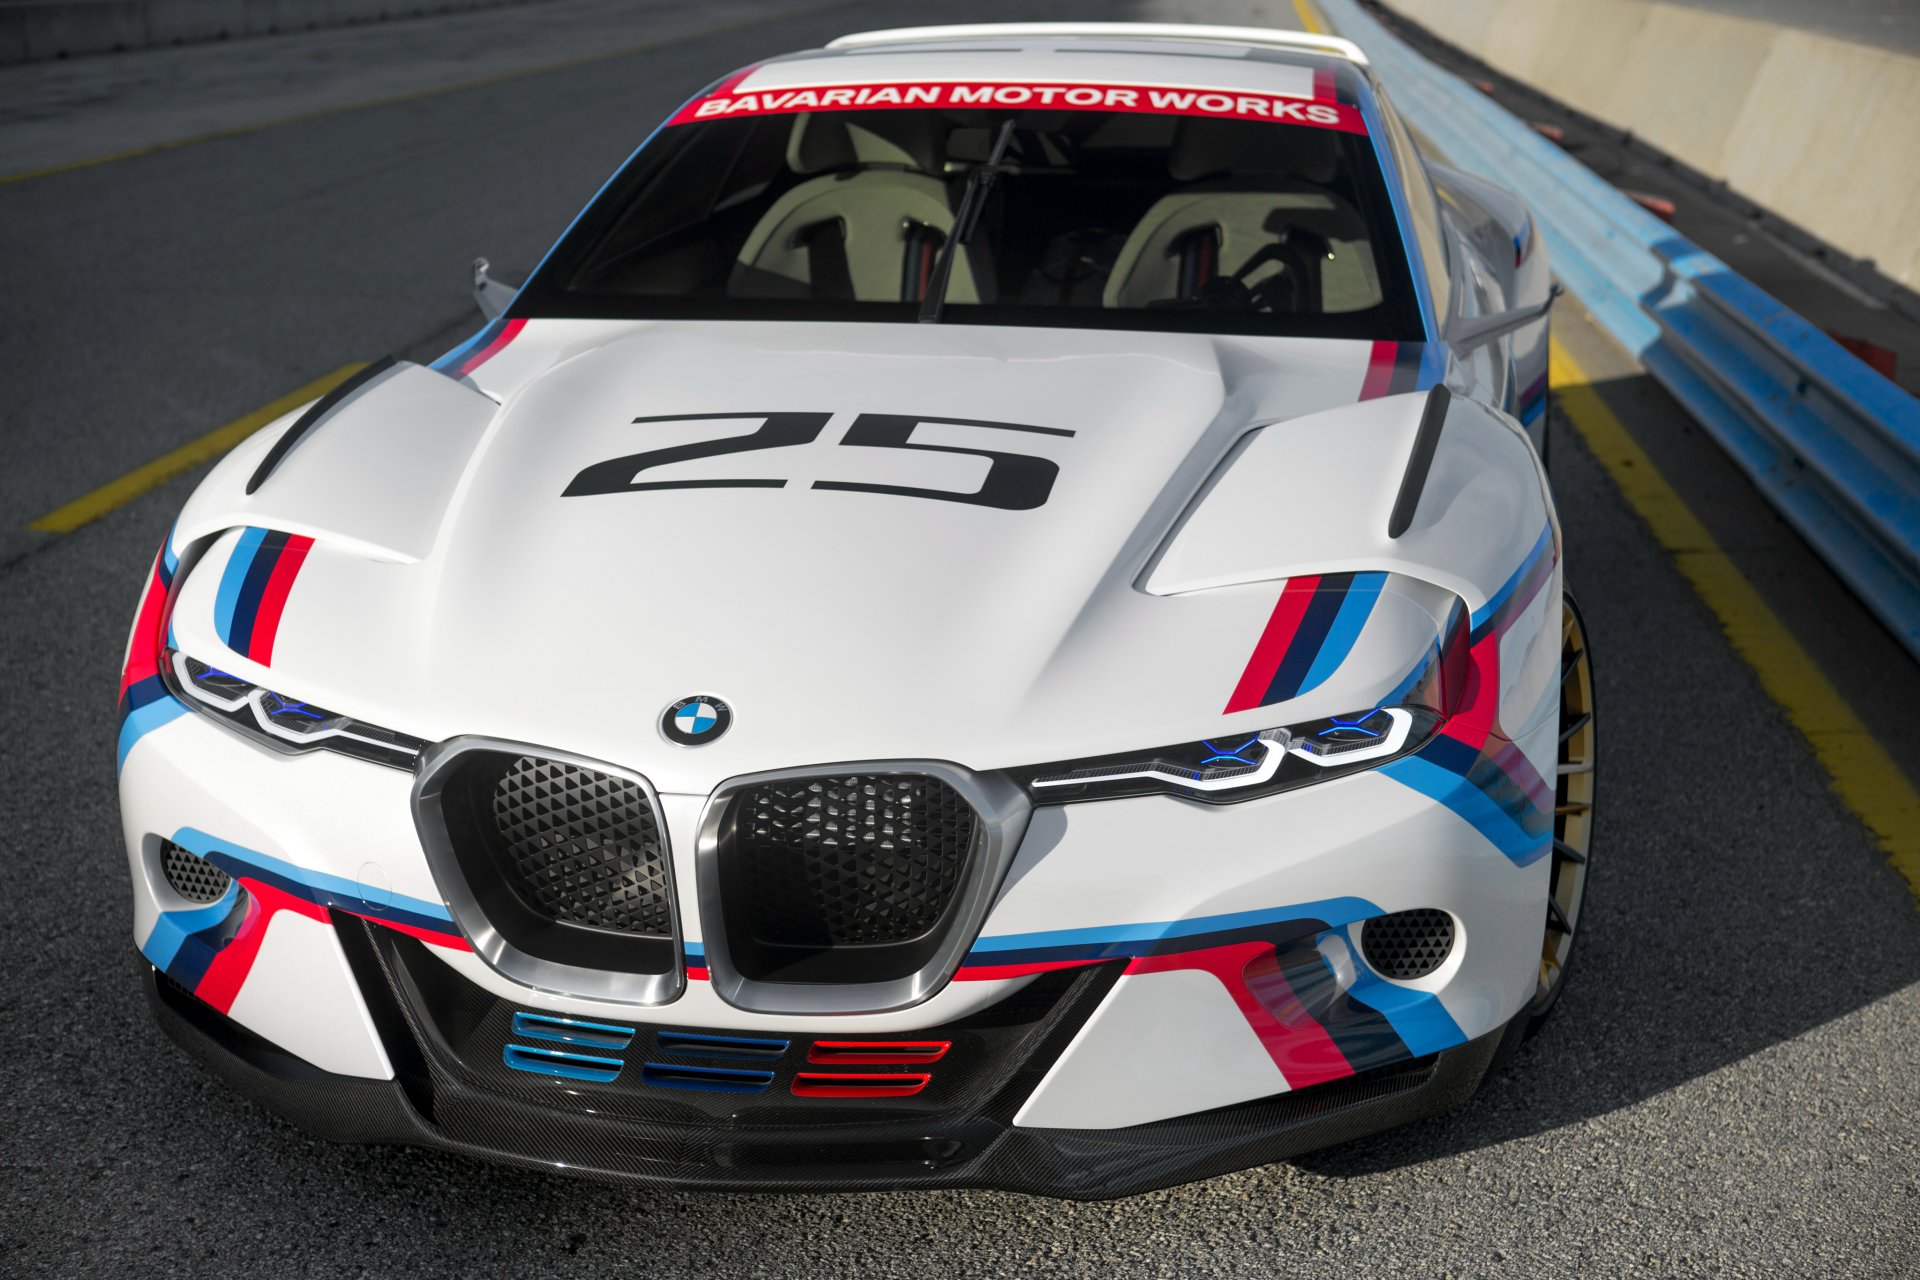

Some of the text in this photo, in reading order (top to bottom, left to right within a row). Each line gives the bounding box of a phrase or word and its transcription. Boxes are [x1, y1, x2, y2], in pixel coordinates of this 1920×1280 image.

[694, 86, 1340, 124] BAVARIAN MOTOR WORKS
[560, 412, 1077, 510] 25
[672, 696, 728, 712] BMW
